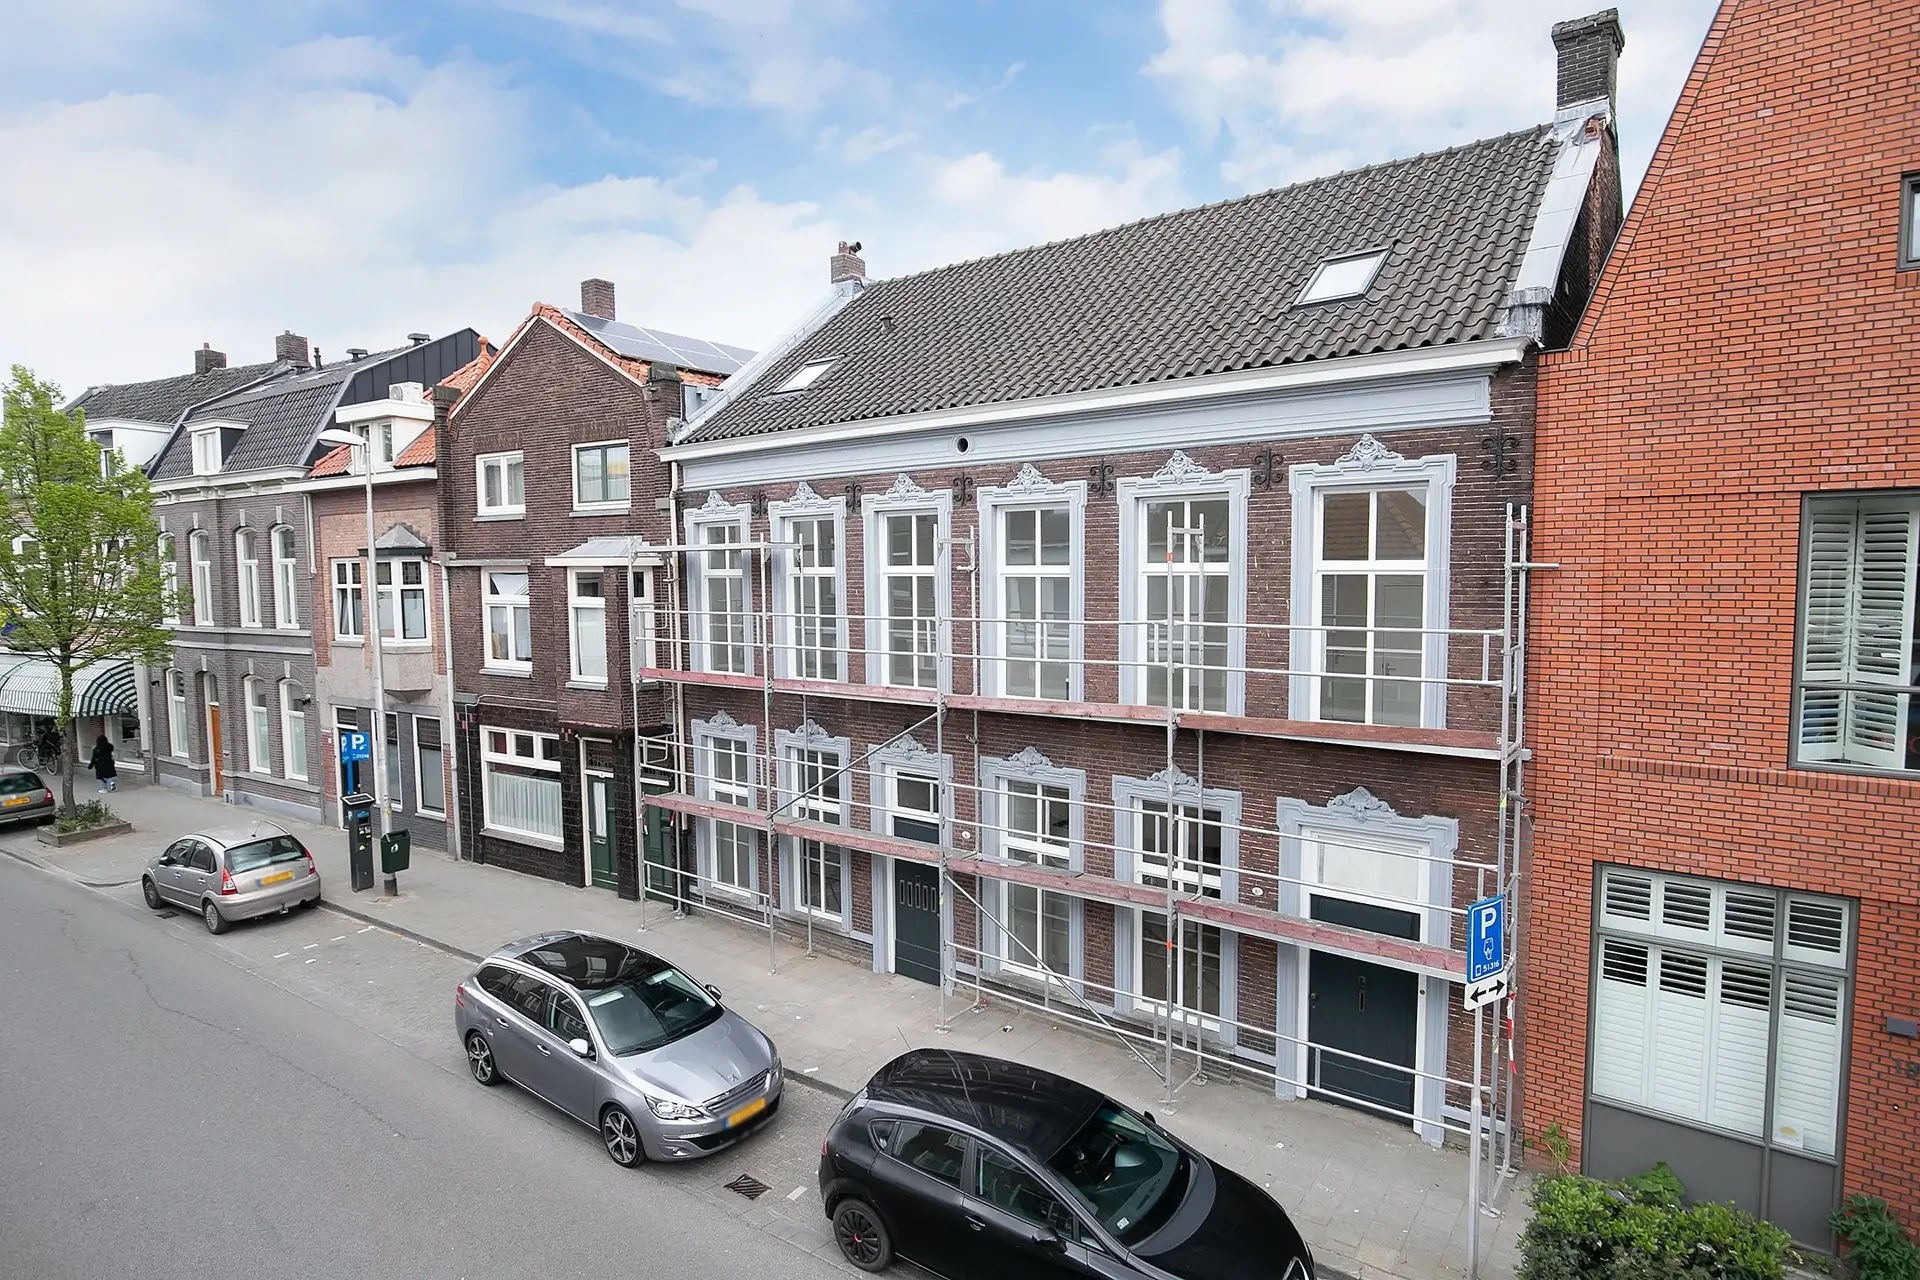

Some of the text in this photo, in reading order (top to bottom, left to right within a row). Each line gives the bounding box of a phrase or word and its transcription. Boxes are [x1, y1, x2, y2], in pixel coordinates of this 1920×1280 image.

[341, 735, 347, 752] P
[351, 734, 365, 750] P
[1481, 907, 1496, 940] P
[1482, 961, 1500, 973] 51316
